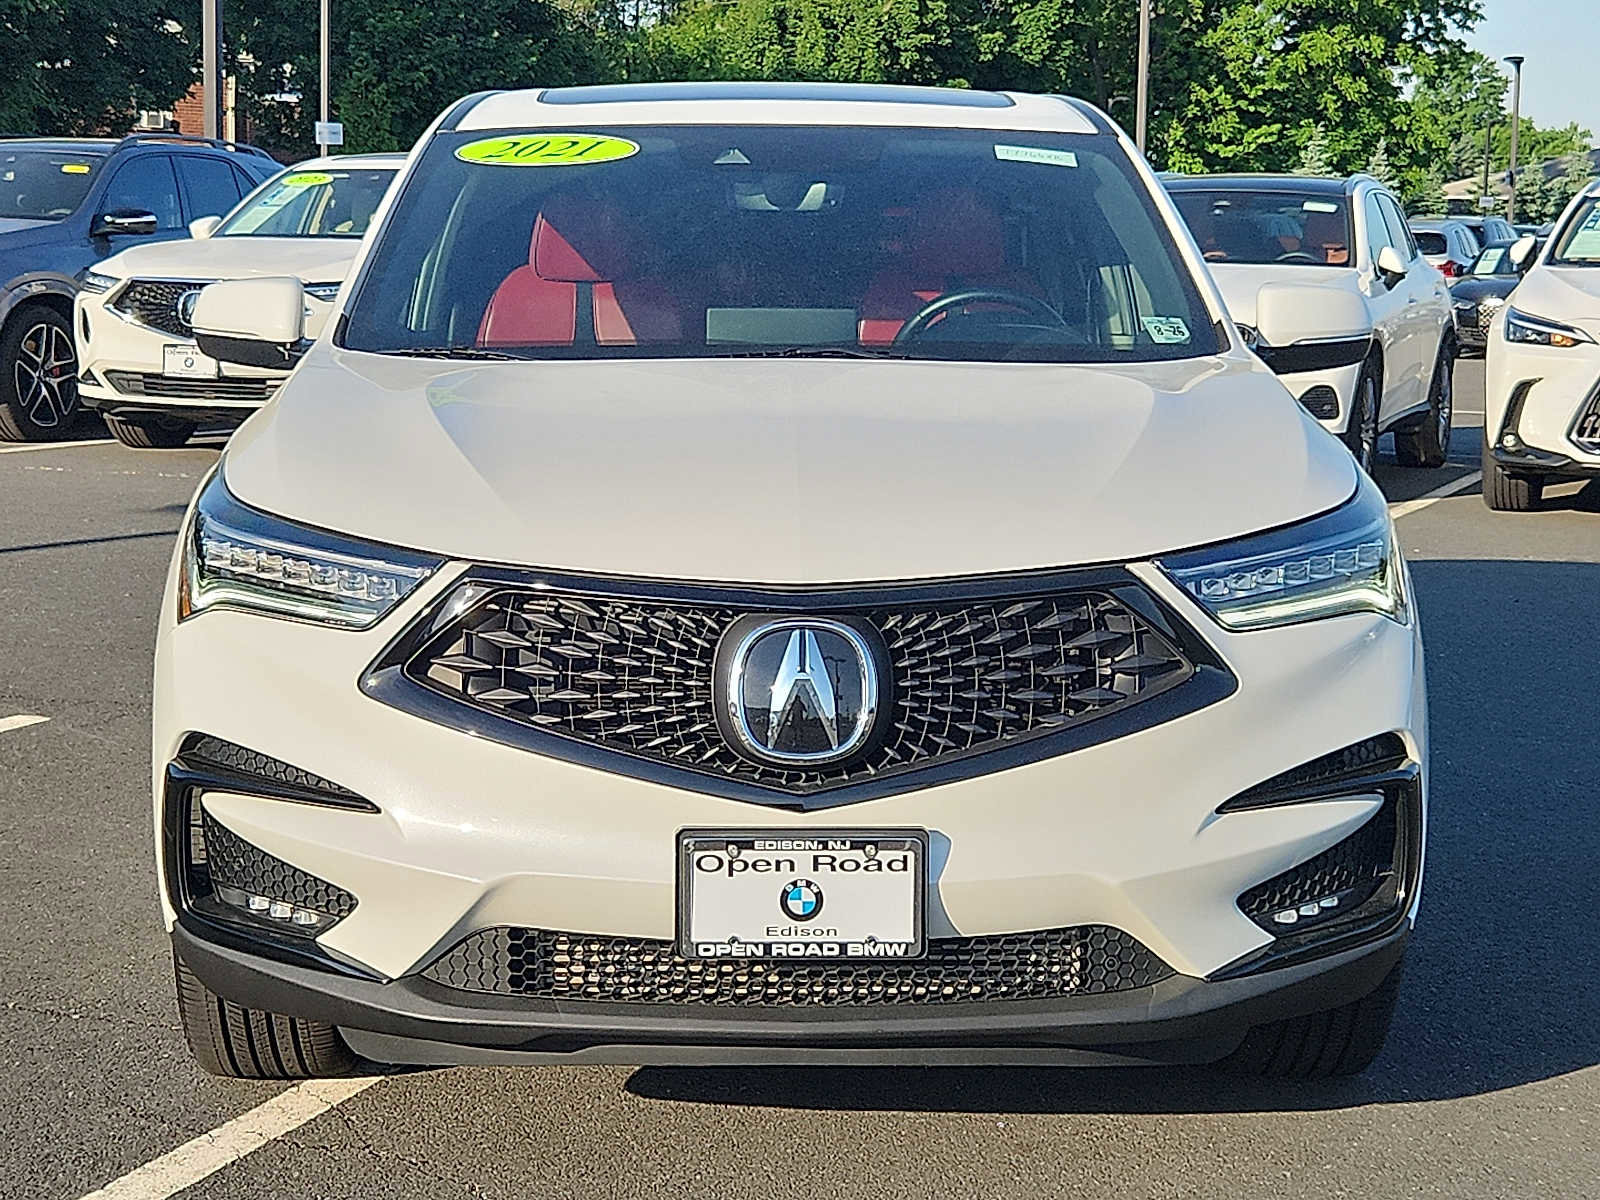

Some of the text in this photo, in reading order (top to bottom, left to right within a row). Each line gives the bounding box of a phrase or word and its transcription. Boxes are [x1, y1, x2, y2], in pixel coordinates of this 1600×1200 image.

[481, 140, 606, 159] 2021
[753, 840, 851, 851] EDISON, NJ
[695, 854, 909, 878] Open Road
[784, 879, 820, 893] BMW
[766, 926, 838, 938] Edison
[697, 943, 907, 957] OPEN ROAD BMW
